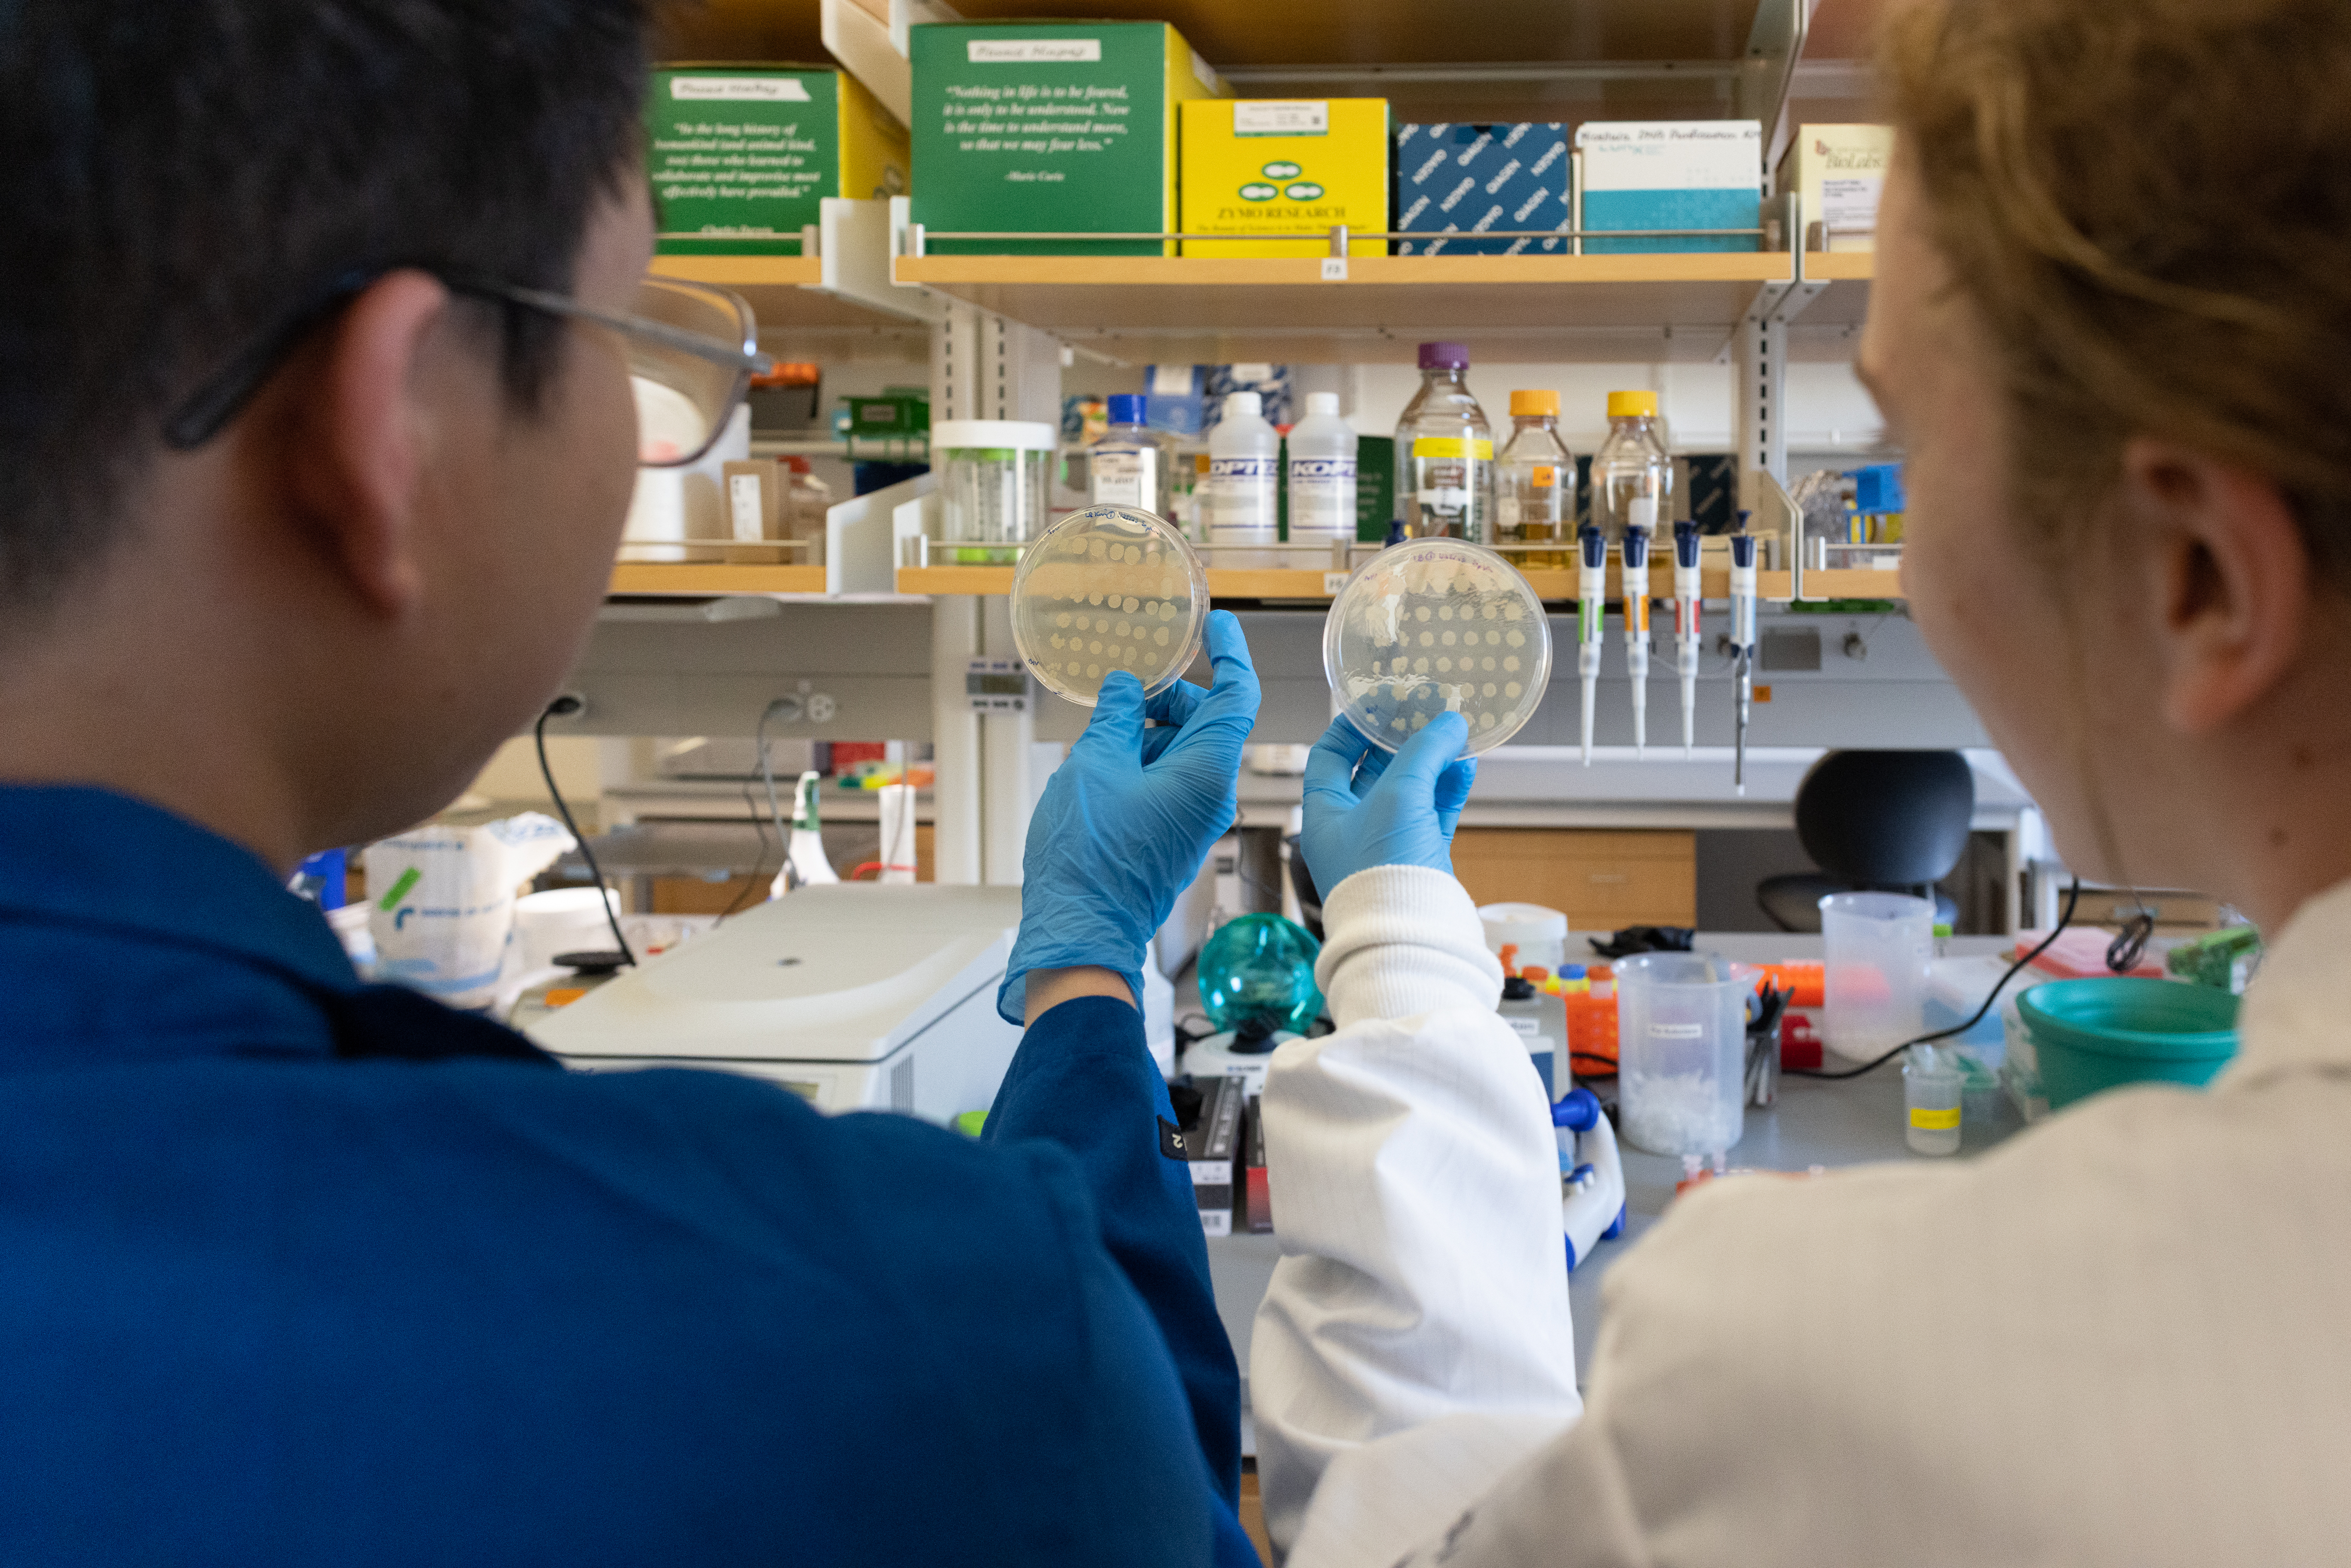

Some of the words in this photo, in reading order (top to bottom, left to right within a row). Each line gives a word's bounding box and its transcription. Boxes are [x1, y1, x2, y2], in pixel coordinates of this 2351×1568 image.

[1068, 85, 1083, 101] be
[1010, 103, 1025, 118] be
[956, 121, 976, 135] the
[975, 137, 1001, 153] that
[1265, 206, 1346, 220] RESEARCH
